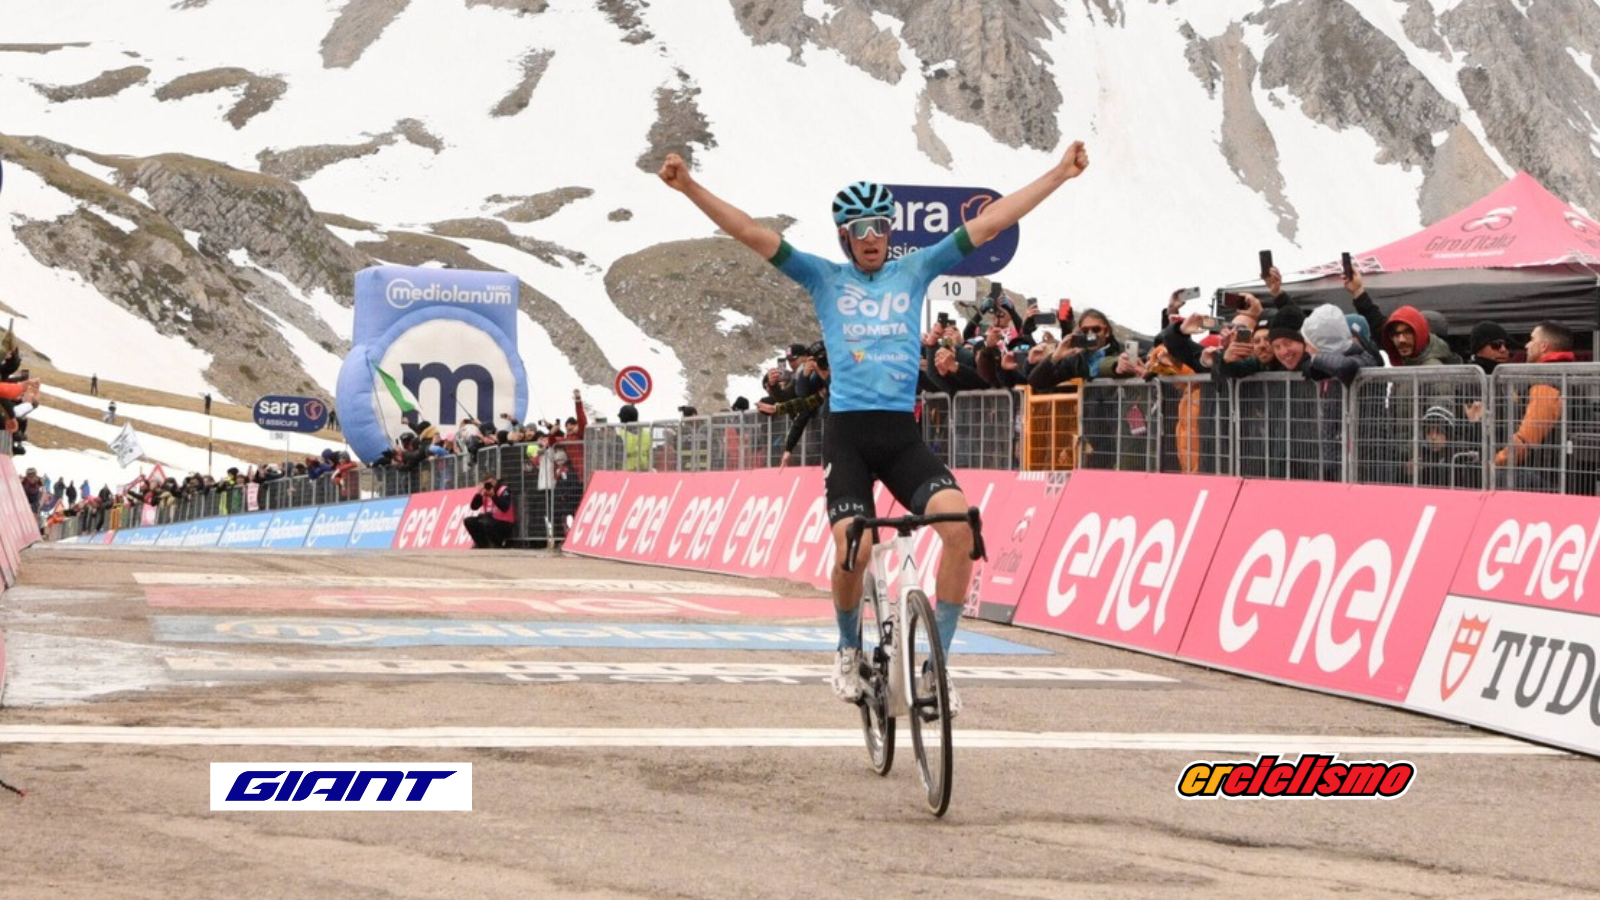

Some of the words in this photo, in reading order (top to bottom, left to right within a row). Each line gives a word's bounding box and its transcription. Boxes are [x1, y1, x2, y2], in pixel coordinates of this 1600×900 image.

[891, 200, 949, 233] ara
[386, 278, 512, 309] mediolanum
[837, 284, 910, 321] eolo
[942, 281, 962, 297] 10
[843, 322, 909, 336] KOMETA
[259, 400, 299, 416] sara
[400, 362, 494, 425] m
[398, 495, 448, 549] enel
[572, 478, 630, 547] enel
[616, 480, 683, 555] enel
[667, 479, 740, 561] enel
[722, 477, 799, 569] enel
[1046, 490, 1208, 636] enel
[1477, 512, 1600, 602] enel
[313, 595, 740, 615] enel
[1219, 505, 1437, 678] enel
